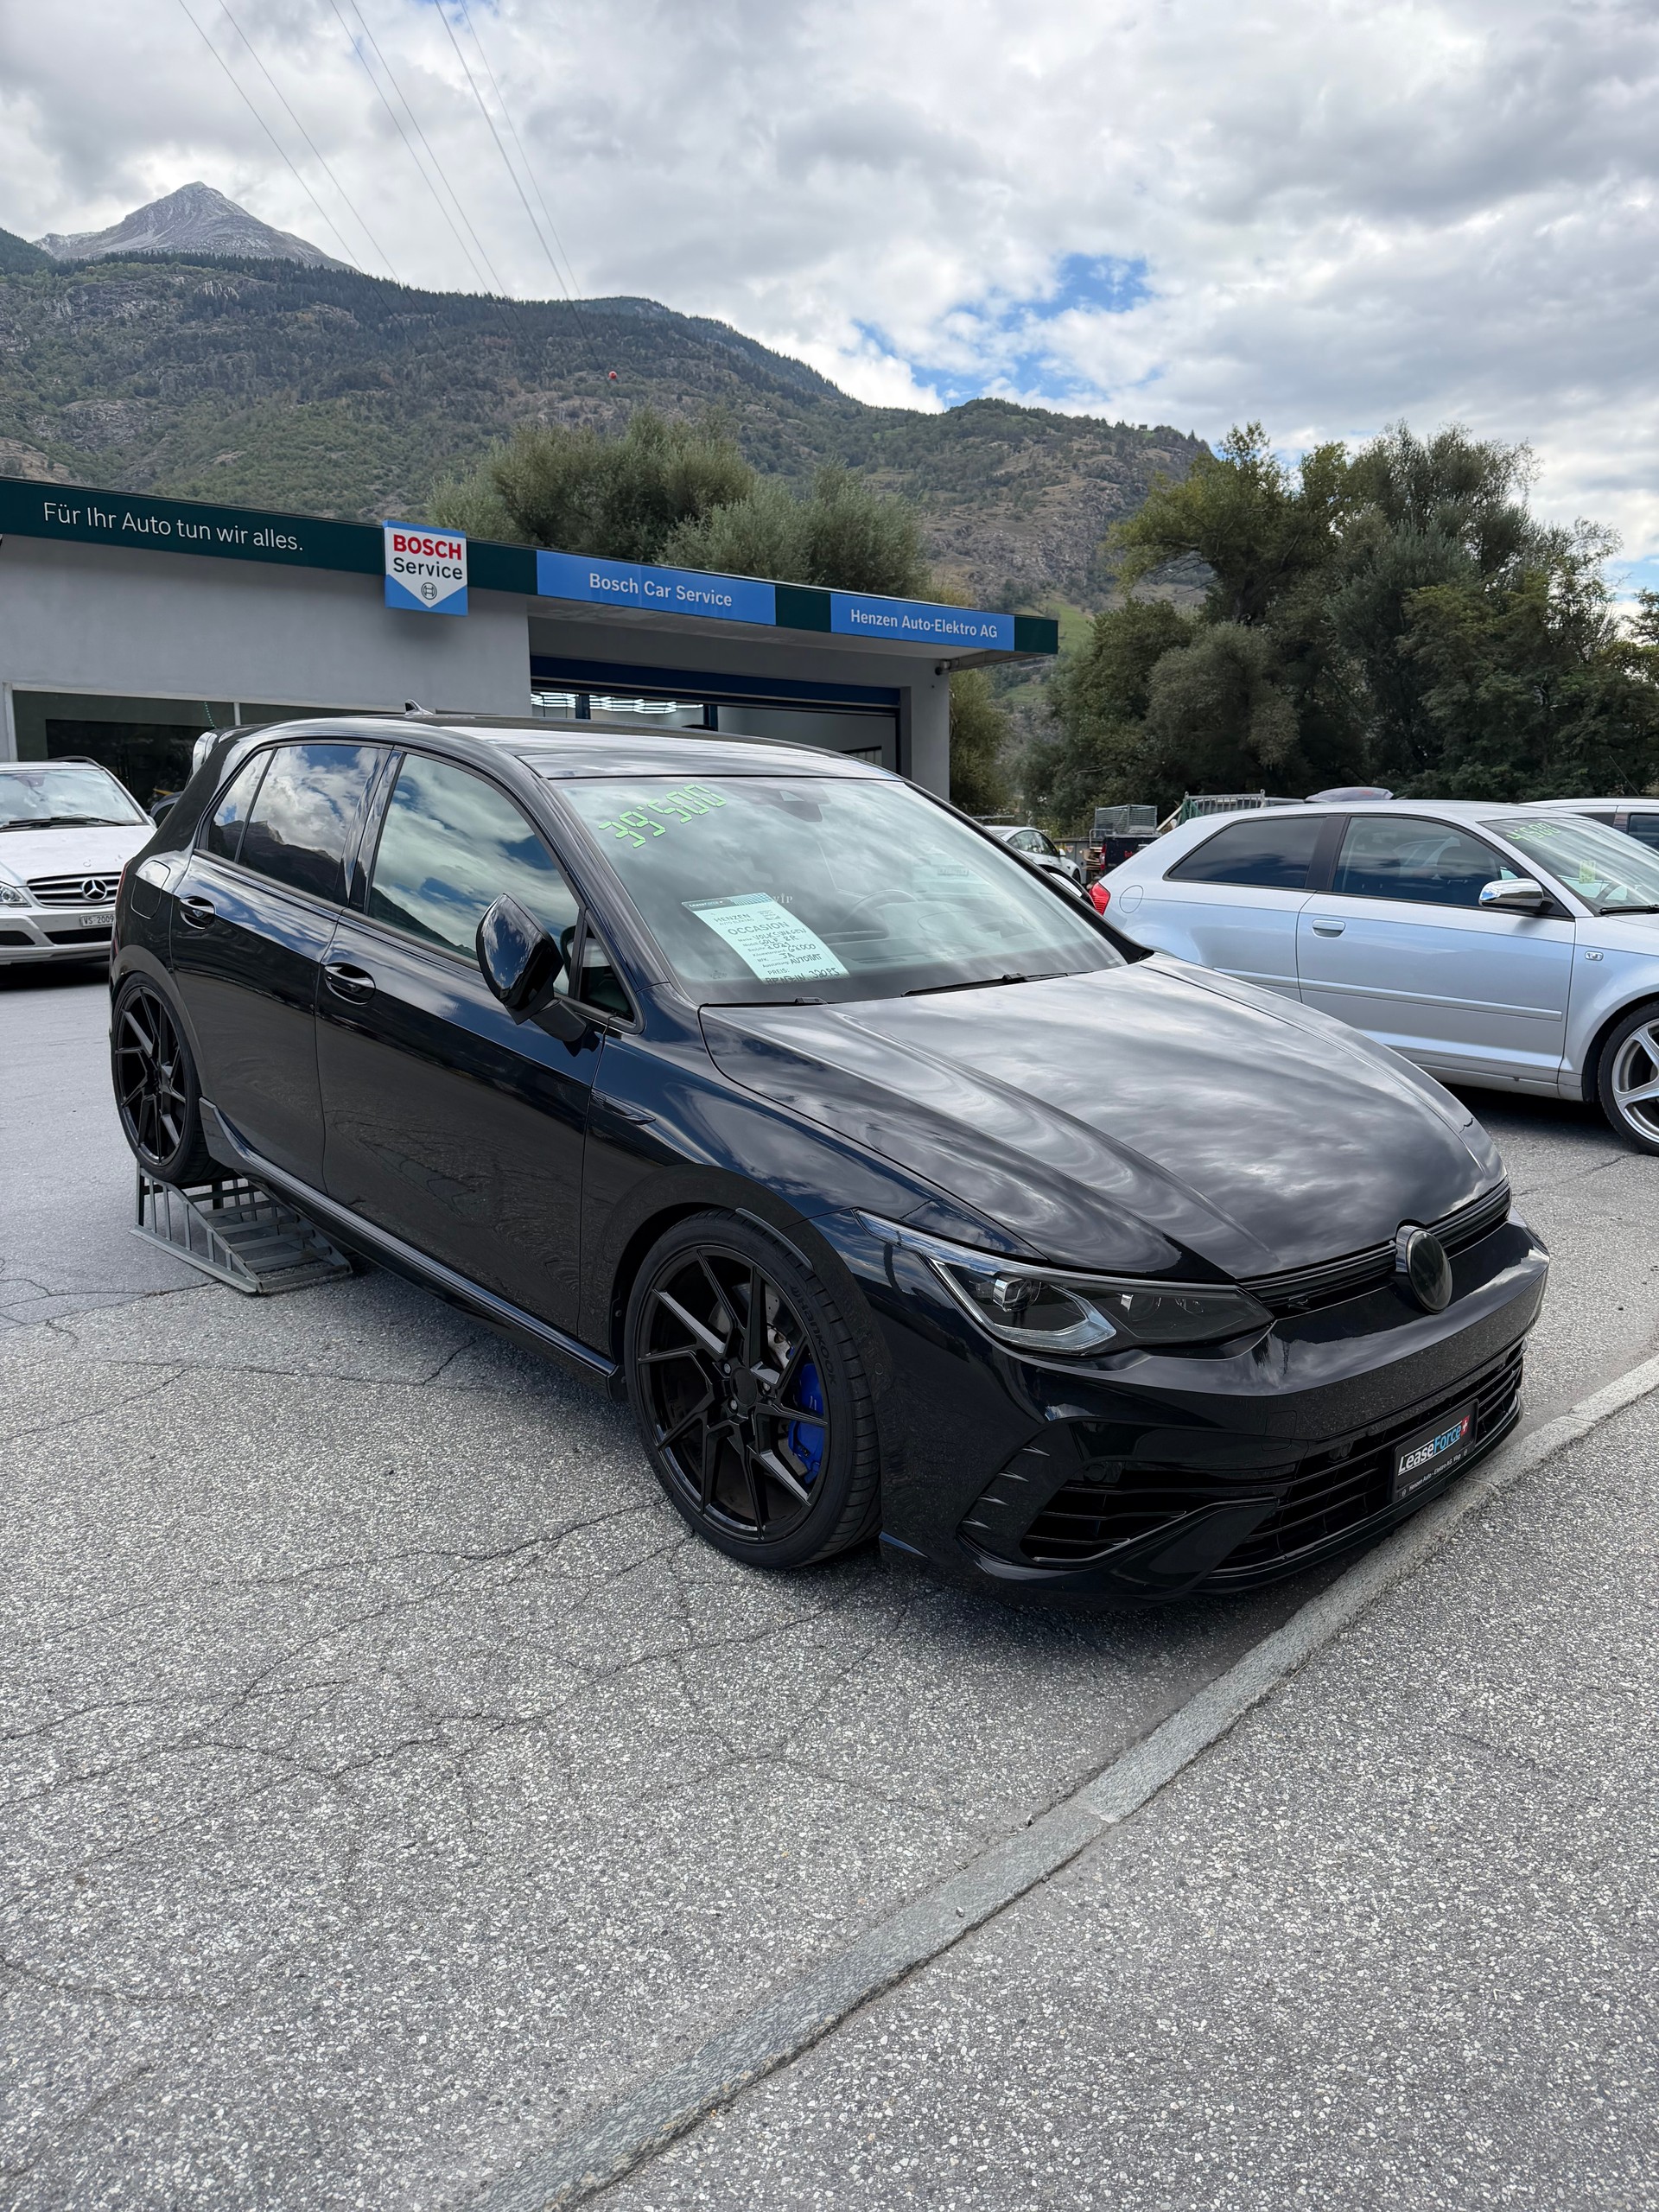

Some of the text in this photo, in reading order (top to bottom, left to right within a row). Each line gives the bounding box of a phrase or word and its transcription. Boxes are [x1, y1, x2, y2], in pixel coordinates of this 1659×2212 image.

[44, 502, 303, 550] Für Ihr Auto tun wir alles.
[393, 534, 461, 561] BOSCH
[393, 557, 463, 580] Service
[589, 573, 732, 607] Bosch Car Service
[850, 608, 997, 638] Henzen Auto-Elektro AG
[83, 916, 92, 925] VS
[714, 913, 751, 923] HENZEN
[728, 921, 790, 935] OCCASION
[753, 928, 807, 939] VOLKSWAGEN
[1399, 1425, 1461, 1472] LeaseForce
